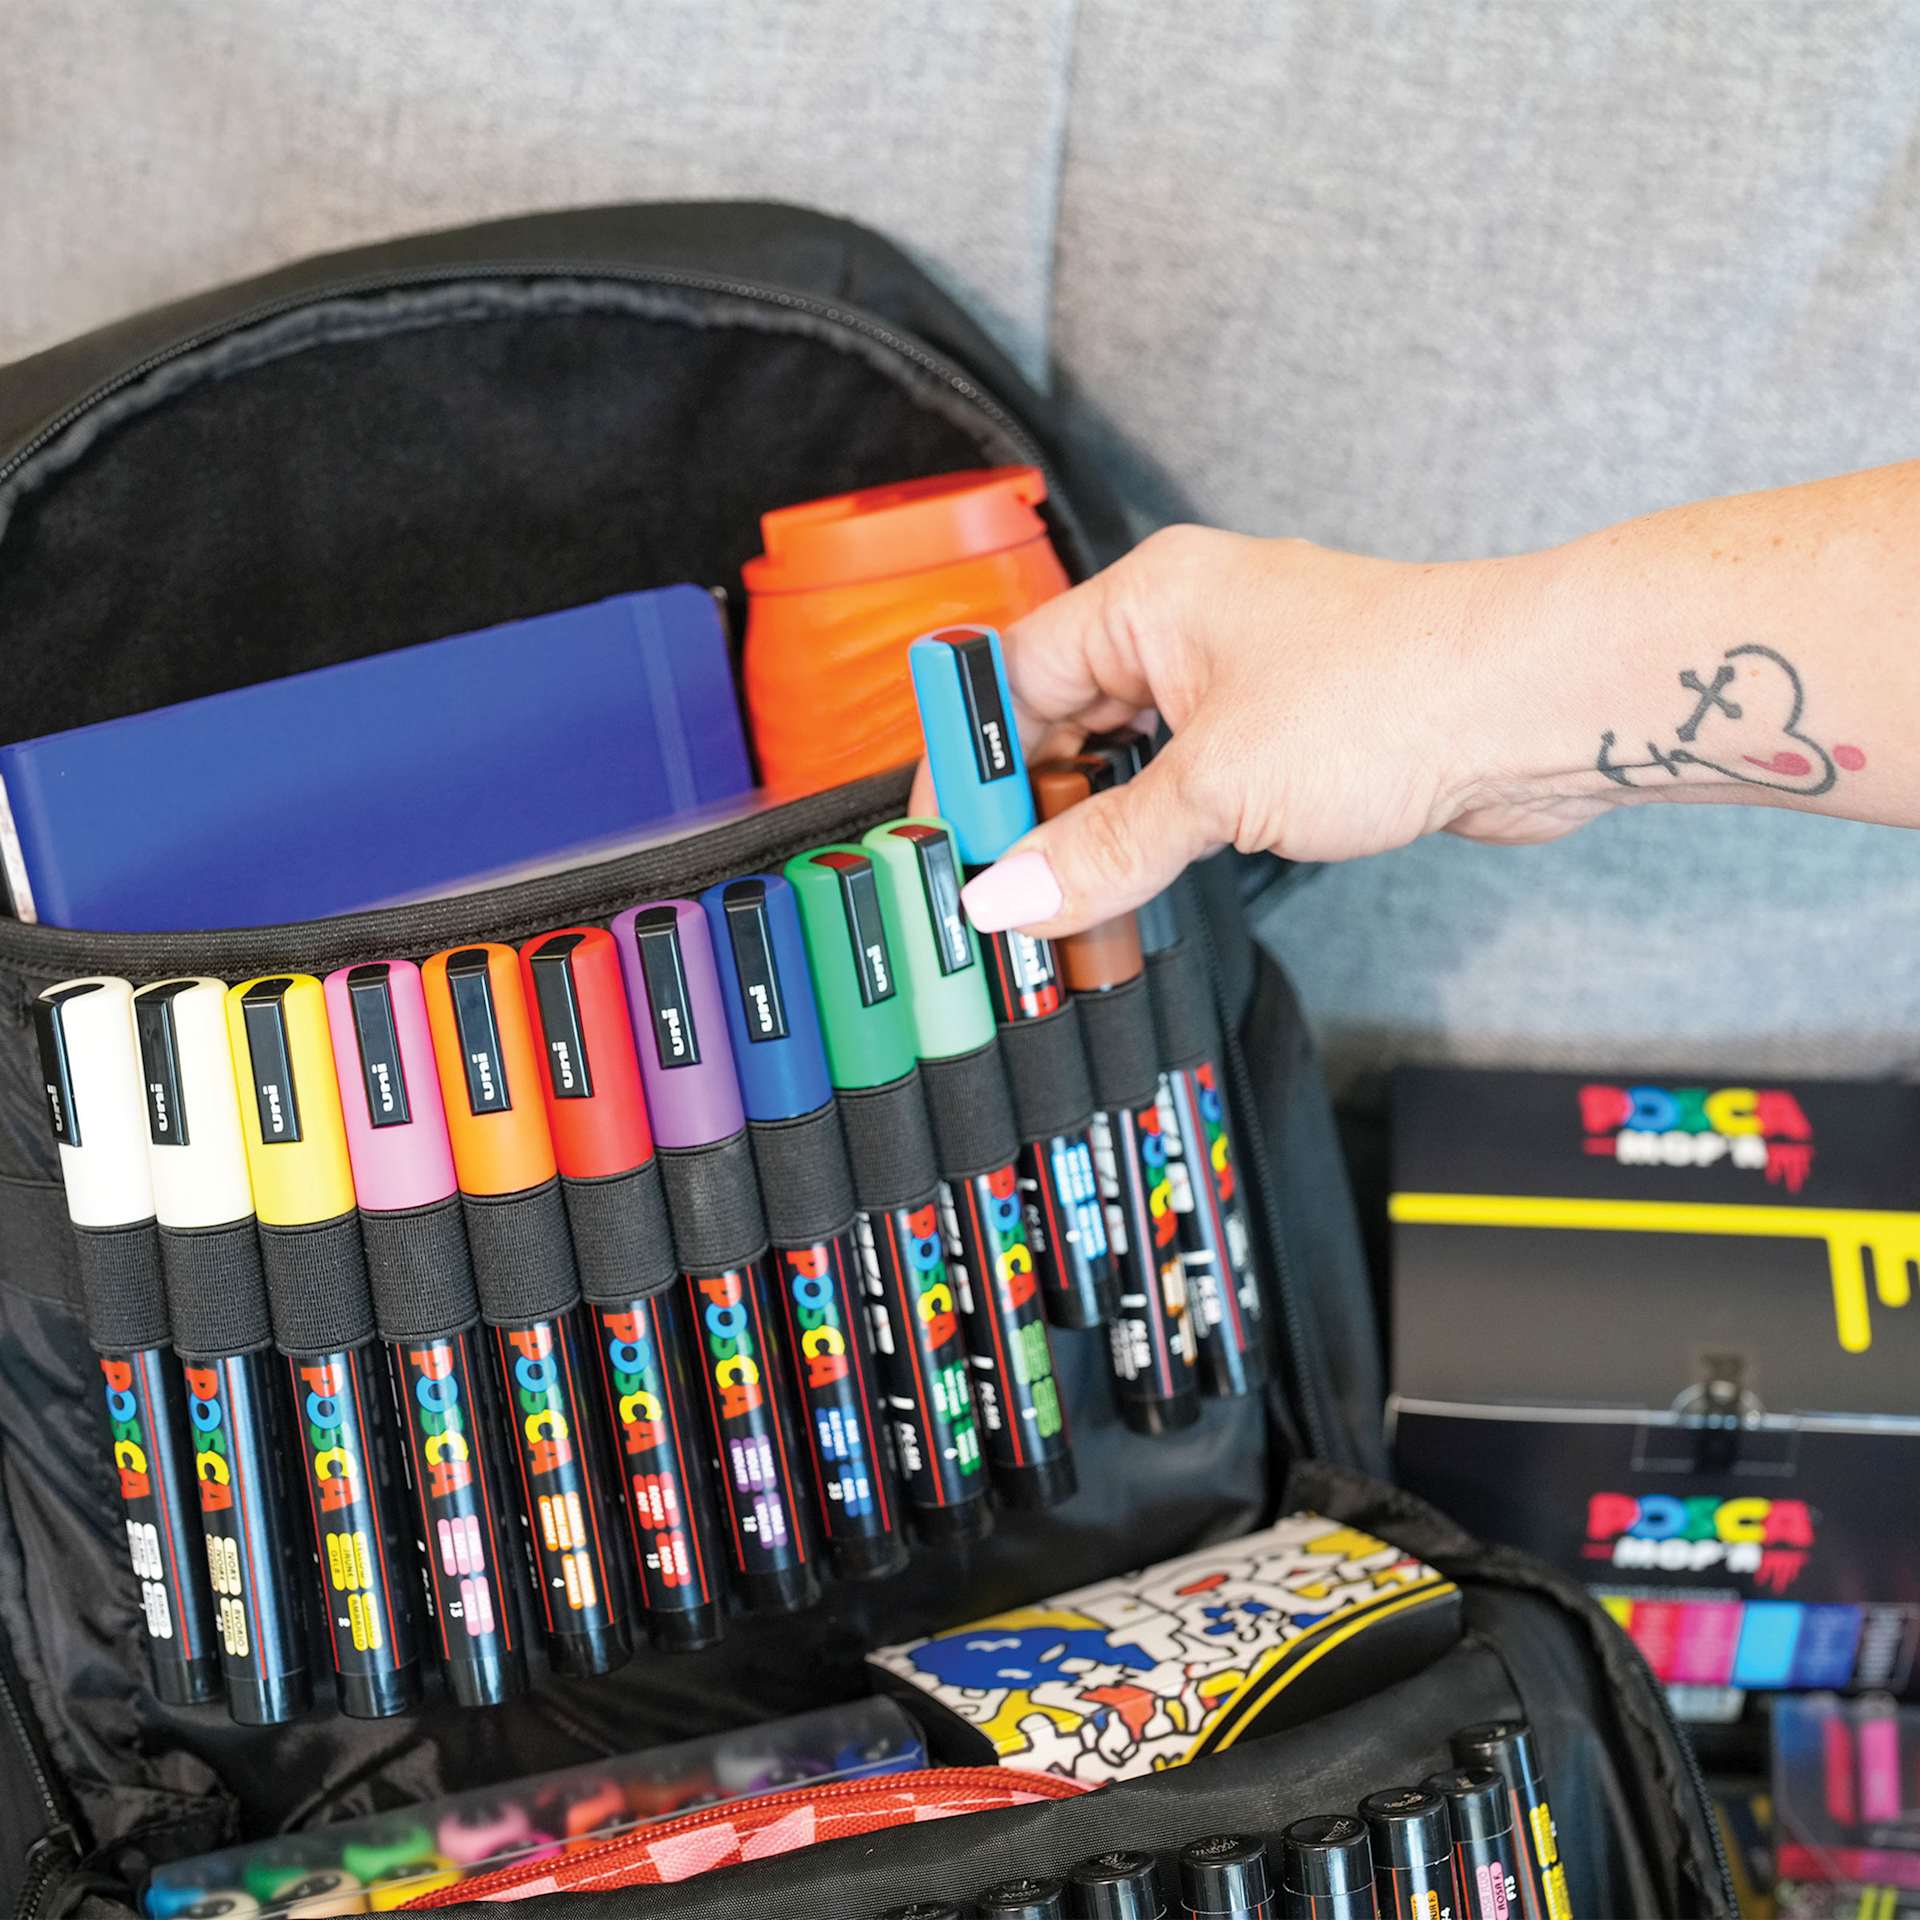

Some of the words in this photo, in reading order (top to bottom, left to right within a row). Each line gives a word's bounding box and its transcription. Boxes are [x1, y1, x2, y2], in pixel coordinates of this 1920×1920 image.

[983, 721, 1006, 769] uni
[945, 915, 966, 962] uni
[867, 945, 888, 992] uni
[750, 984, 773, 1032] uni
[661, 1008, 685, 1057] uni
[372, 1063, 394, 1112] uni
[472, 1052, 494, 1100] uni
[552, 1042, 574, 1088] uni
[47, 1084, 63, 1132] uni
[150, 1084, 168, 1132] uni
[262, 1084, 284, 1133] uni
[1578, 1085, 1812, 1139] POSCA
[985, 1164, 1036, 1312] POSCA
[903, 1205, 957, 1351] POSCA
[787, 1246, 848, 1388] POSCA
[700, 1274, 763, 1419] POSCA
[510, 1328, 573, 1475] POSCA
[604, 1310, 666, 1455] POSCA
[101, 1360, 150, 1499] POSCA
[187, 1368, 233, 1512] POSCA
[302, 1364, 361, 1512] POSCA
[412, 1346, 473, 1498] POSCA
[1587, 1492, 1814, 1546] POSCA
[226, 1551, 238, 1582] IVORY
[331, 1550, 342, 1574] GELB
[343, 1548, 355, 1577] JAUNE
[552, 1577, 565, 1588] 4
[647, 1553, 661, 1570] 15
[233, 1608, 247, 1648] AVORIO
[339, 1617, 351, 1628] 2
[350, 1598, 366, 1648] AMARILLO
[450, 1602, 464, 1618] 13
[1492, 1872, 1501, 1880] F.
[1494, 1882, 1505, 1910] ROSA
[1503, 1874, 1517, 1900] F13
